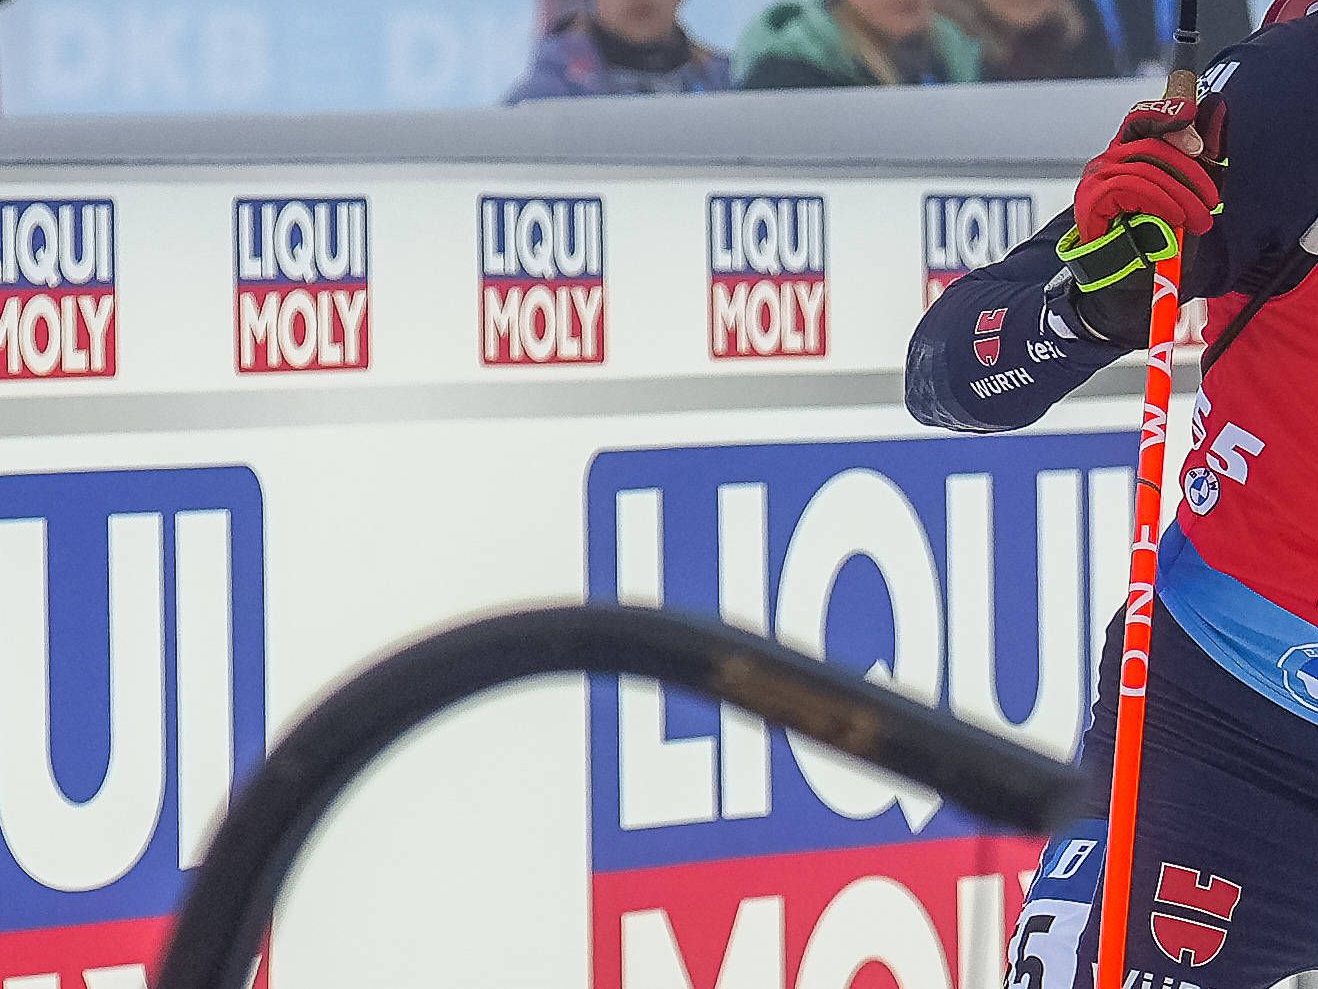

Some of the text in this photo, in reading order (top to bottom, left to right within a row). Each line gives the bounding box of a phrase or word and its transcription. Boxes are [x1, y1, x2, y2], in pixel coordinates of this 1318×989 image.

[32, 4, 268, 99] DKB
[0, 201, 112, 287] IQUI
[238, 201, 365, 283] LIQUI
[484, 200, 600, 280] LIQUI
[712, 198, 823, 276] LIQUI
[239, 289, 367, 369] MOLY
[484, 283, 602, 361] MOLY
[712, 279, 824, 355] MOLY
[1140, 273, 1179, 450] WAY
